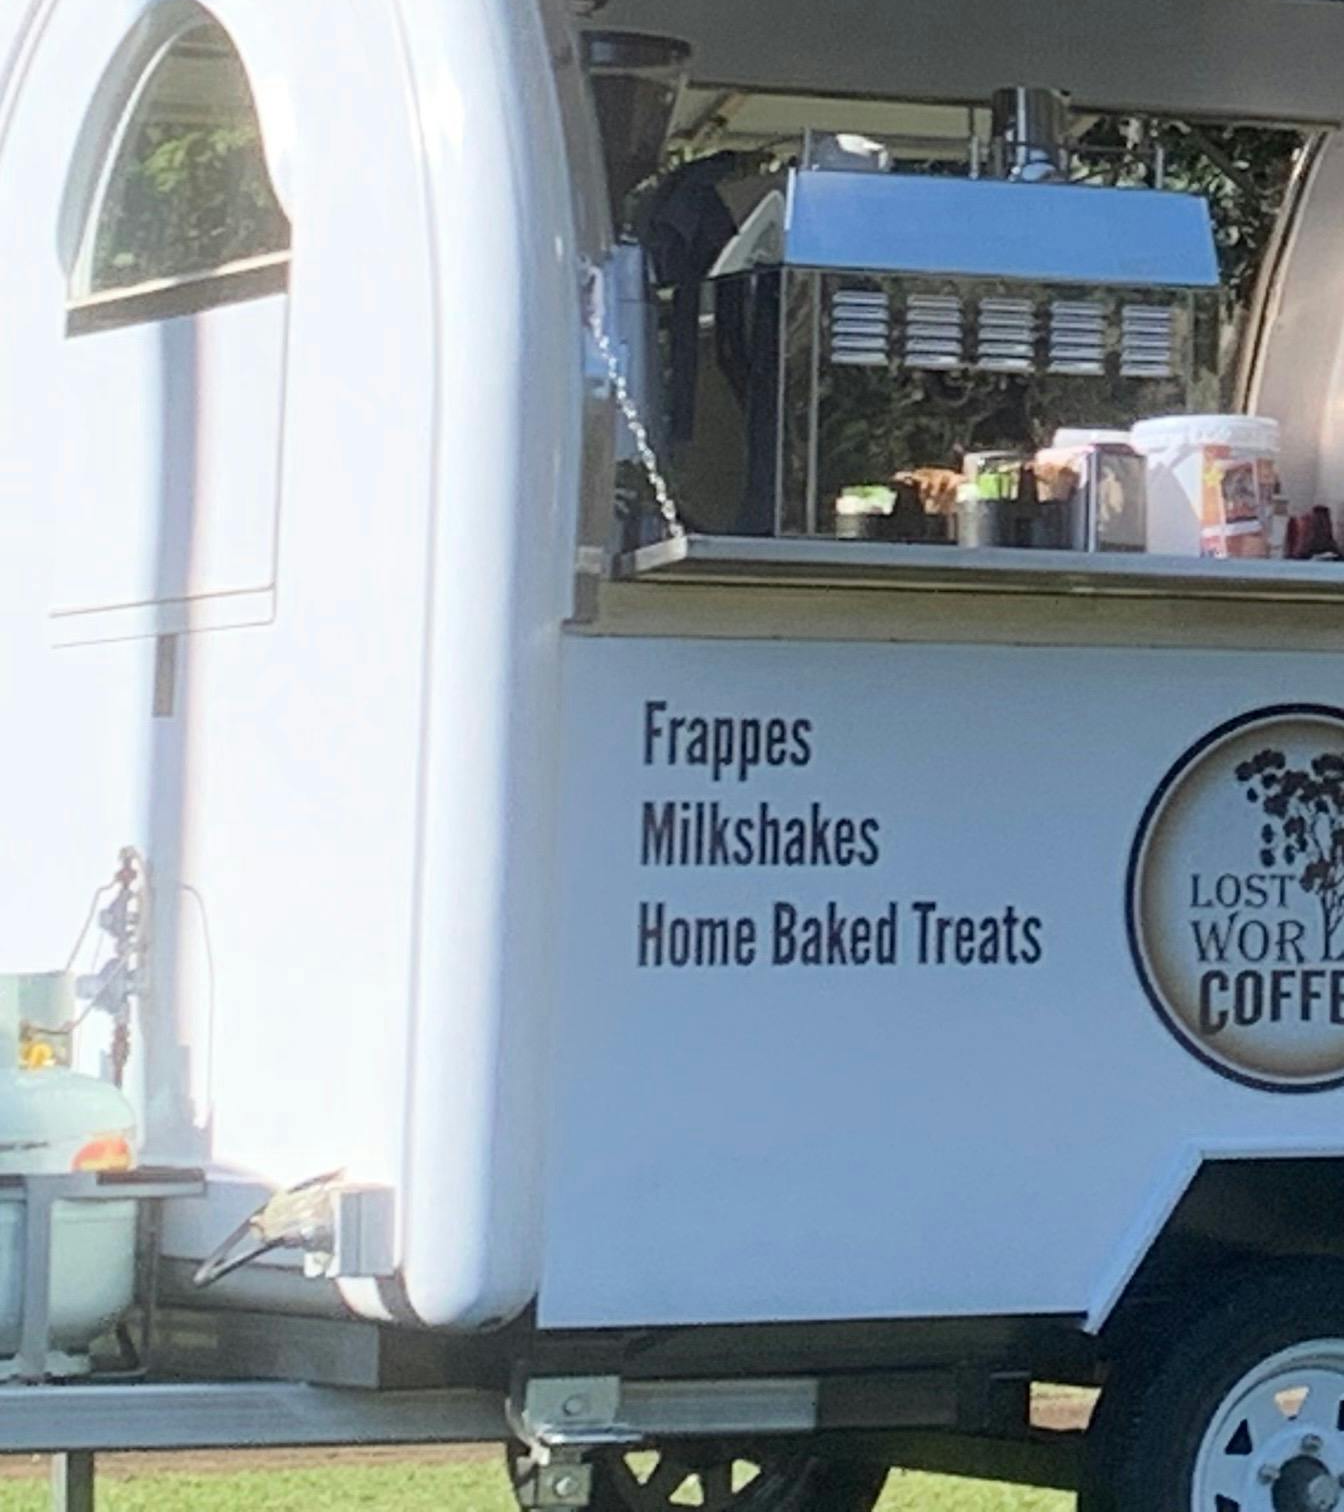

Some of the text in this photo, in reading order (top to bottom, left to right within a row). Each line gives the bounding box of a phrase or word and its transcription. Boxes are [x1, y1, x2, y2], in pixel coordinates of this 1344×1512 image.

[643, 700, 813, 782] Frappes
[640, 801, 880, 867] Milkshakes
[1190, 872, 1299, 909] LOST
[637, 901, 1043, 967] Home Baked Treats
